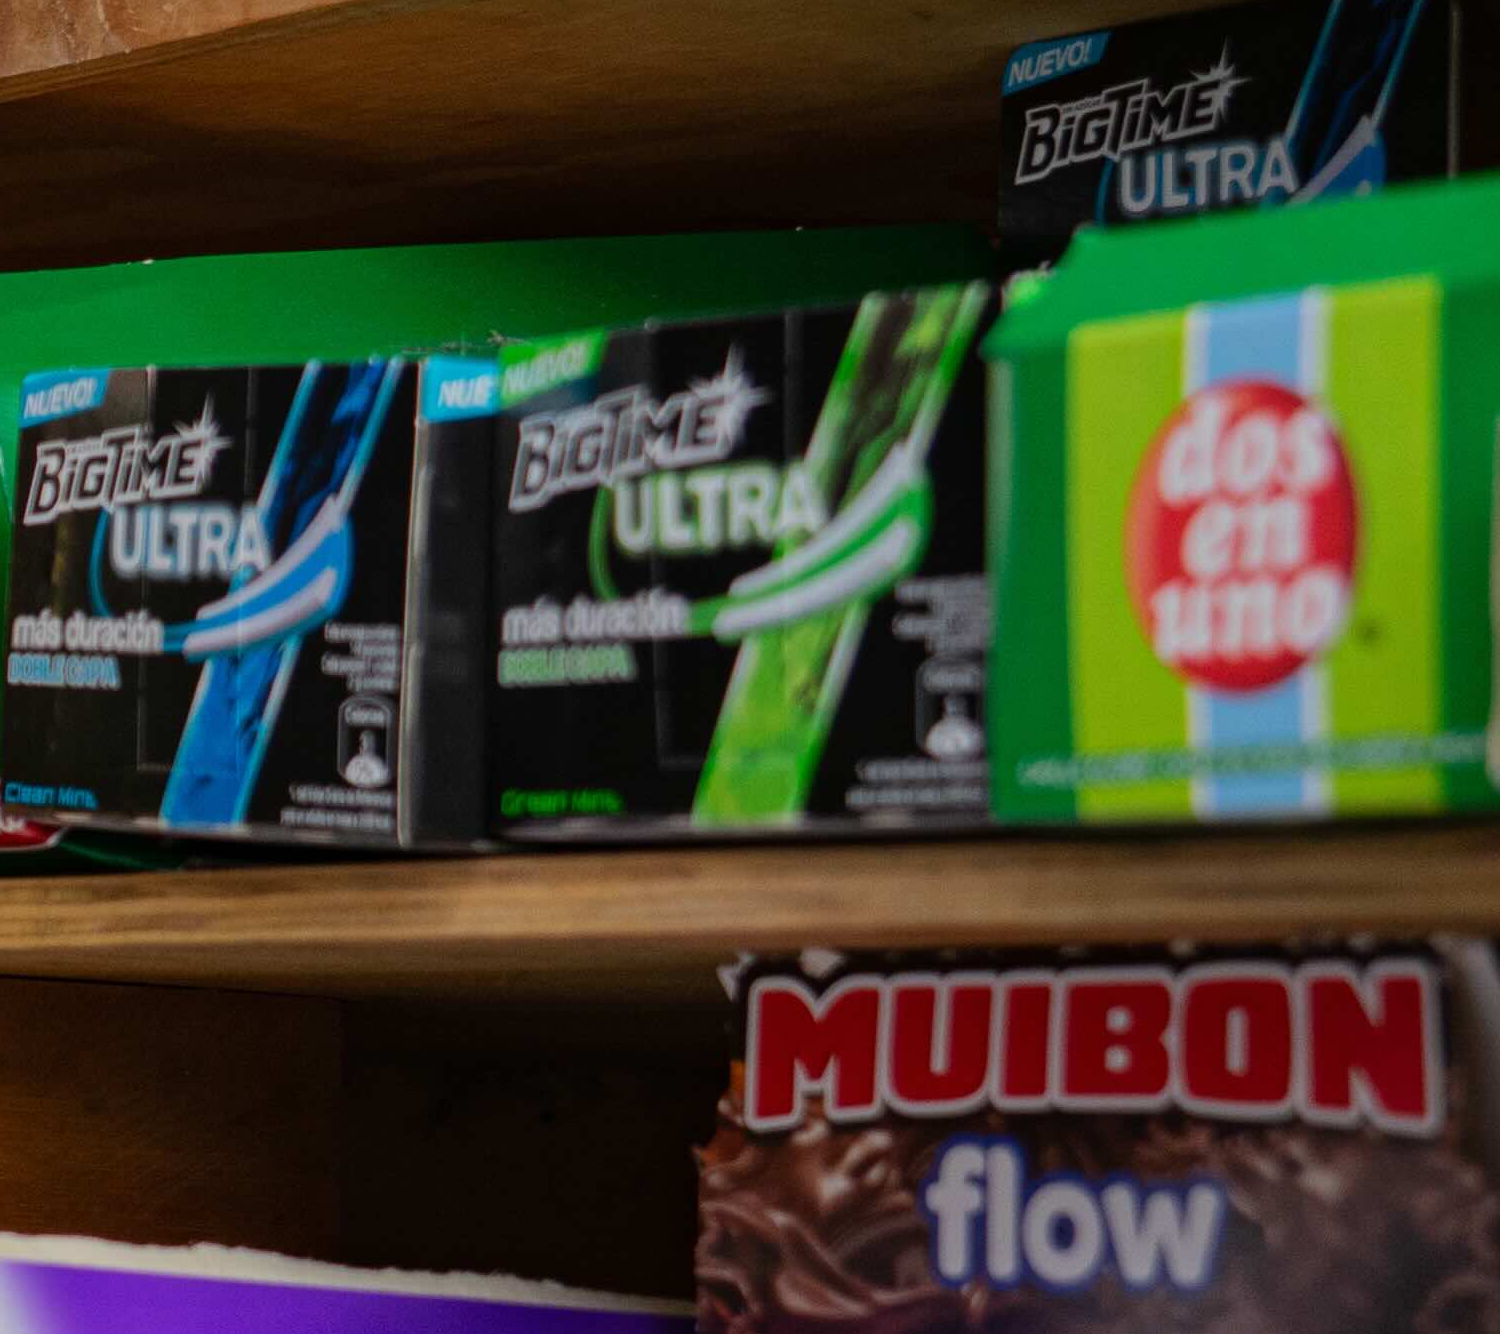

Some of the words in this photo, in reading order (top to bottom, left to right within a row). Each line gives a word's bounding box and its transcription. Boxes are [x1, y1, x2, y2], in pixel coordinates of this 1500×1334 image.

[1008, 39, 1093, 87] NUEVO!
[1120, 137, 1299, 213] ULTRA
[24, 379, 98, 419] NUEVO!
[1159, 394, 1334, 506] dos
[112, 505, 272, 573] ULTRA
[613, 466, 826, 554] ULTRA
[1182, 497, 1305, 577] en
[12, 613, 61, 648] más
[64, 610, 164, 652] duración
[503, 597, 560, 645] más
[565, 586, 688, 639] duración
[1152, 565, 1349, 661] uno
[5, 783, 54, 804] Clean
[745, 957, 1445, 1138] MUIBON
[923, 1135, 1225, 1290] flow
